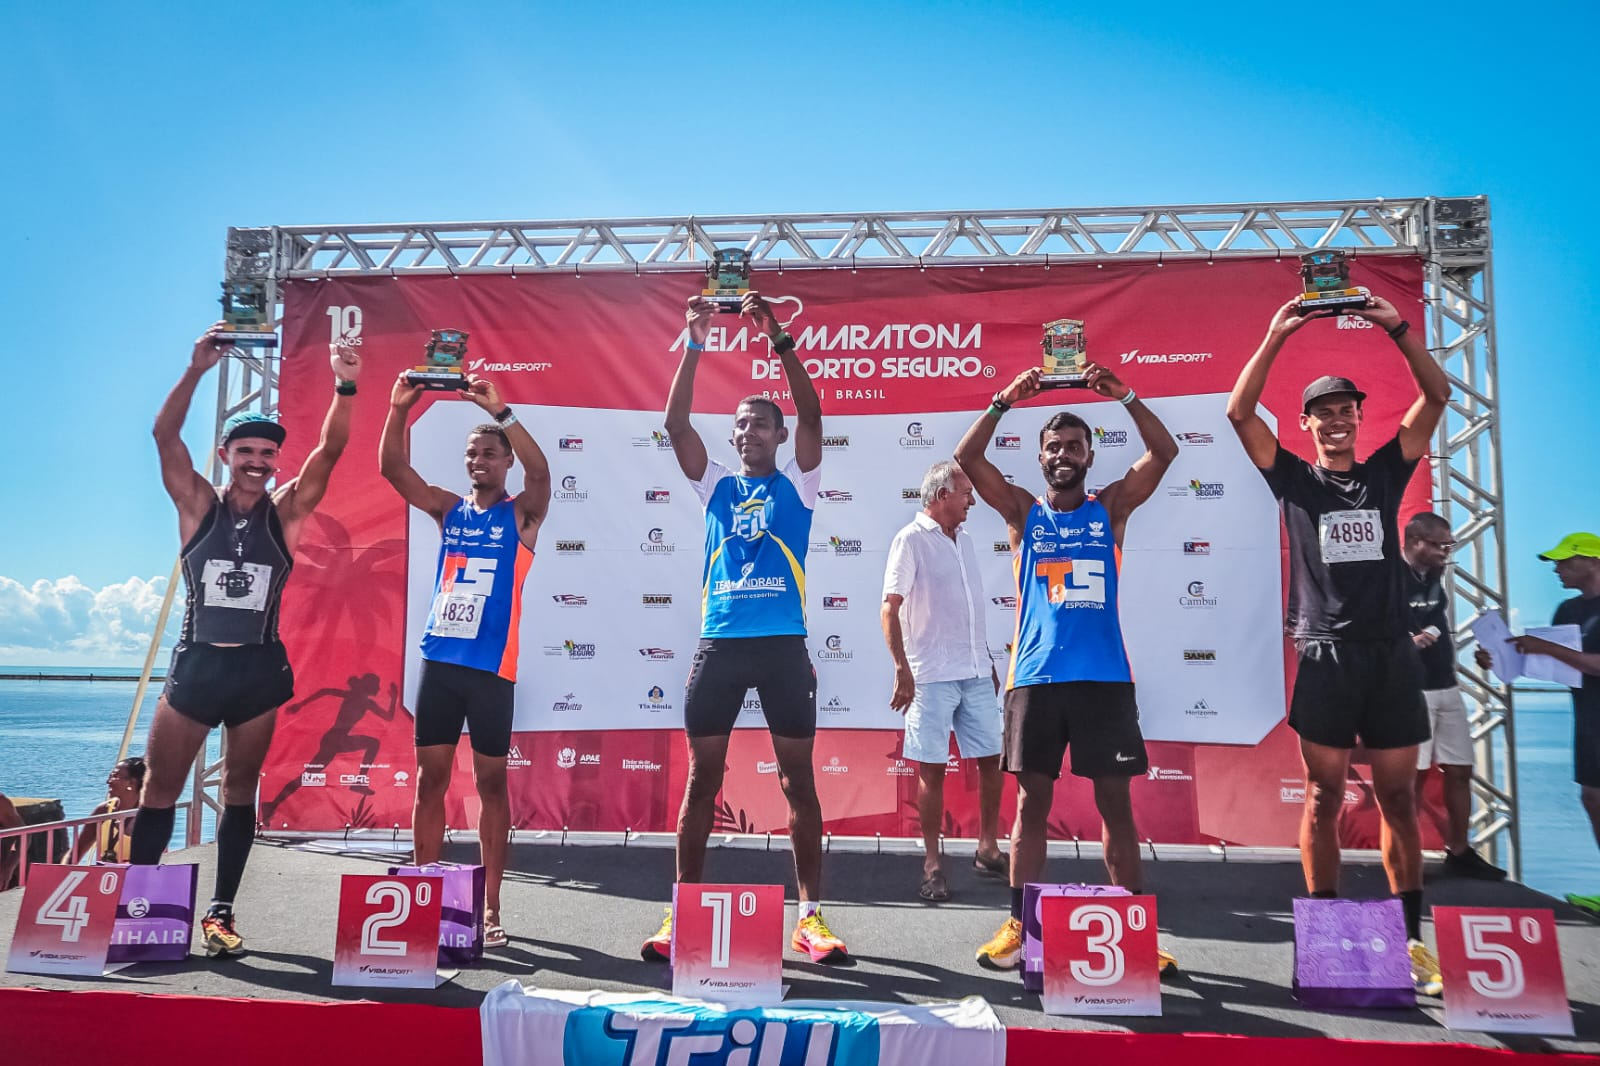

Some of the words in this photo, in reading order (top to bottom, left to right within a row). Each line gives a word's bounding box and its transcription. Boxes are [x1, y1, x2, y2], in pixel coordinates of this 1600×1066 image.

[326, 305, 363, 343] 10
[793, 323, 982, 350] MARATONA
[752, 358, 781, 380] DE
[804, 357, 876, 380] ORTO
[836, 389, 886, 399] BRASIL
[1195, 489, 1224, 497] SEGURO
[1330, 521, 1375, 544] 4898
[1065, 602, 1104, 610] ESPORTIVA
[580, 754, 600, 762] APAE
